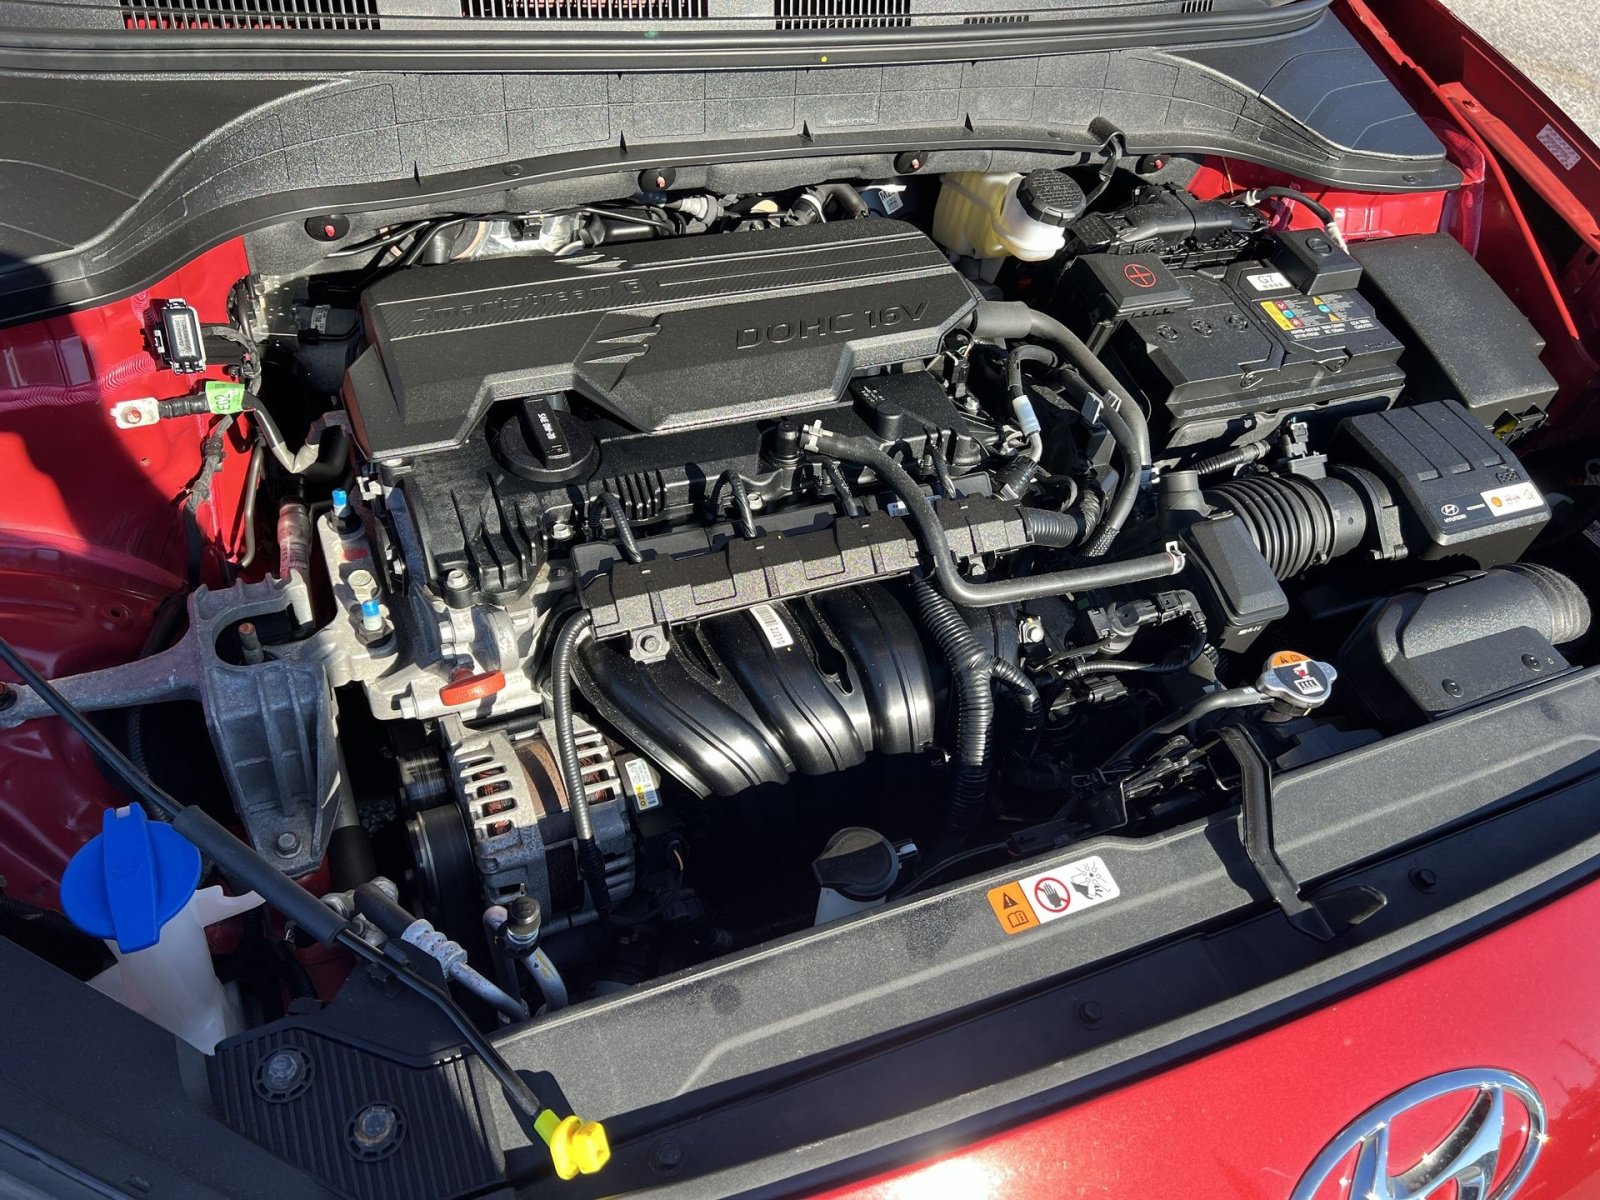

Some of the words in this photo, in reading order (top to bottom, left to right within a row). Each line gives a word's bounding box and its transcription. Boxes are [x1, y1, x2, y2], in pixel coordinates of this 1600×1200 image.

[1257, 274, 1274, 285] G7
[736, 313, 854, 350] DOHC
[864, 301, 930, 329] 16V
[537, 412, 550, 425] SAE
[1443, 514, 1467, 524] HYUNDAI
